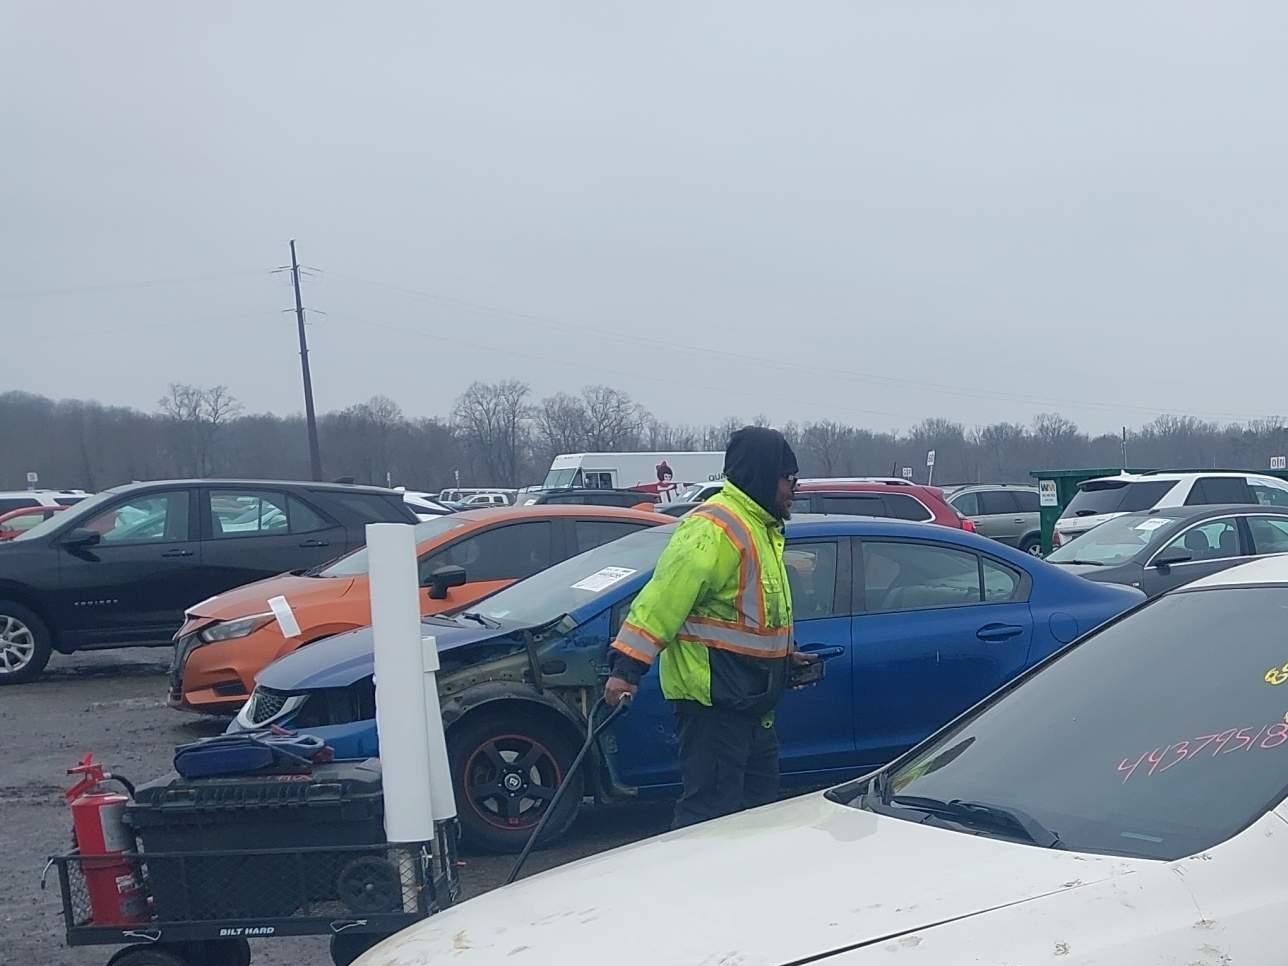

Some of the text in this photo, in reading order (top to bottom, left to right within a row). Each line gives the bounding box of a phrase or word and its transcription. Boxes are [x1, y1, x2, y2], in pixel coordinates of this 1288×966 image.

[1118, 723, 1288, 784] 44379518
[220, 926, 275, 936] BILT HARD
